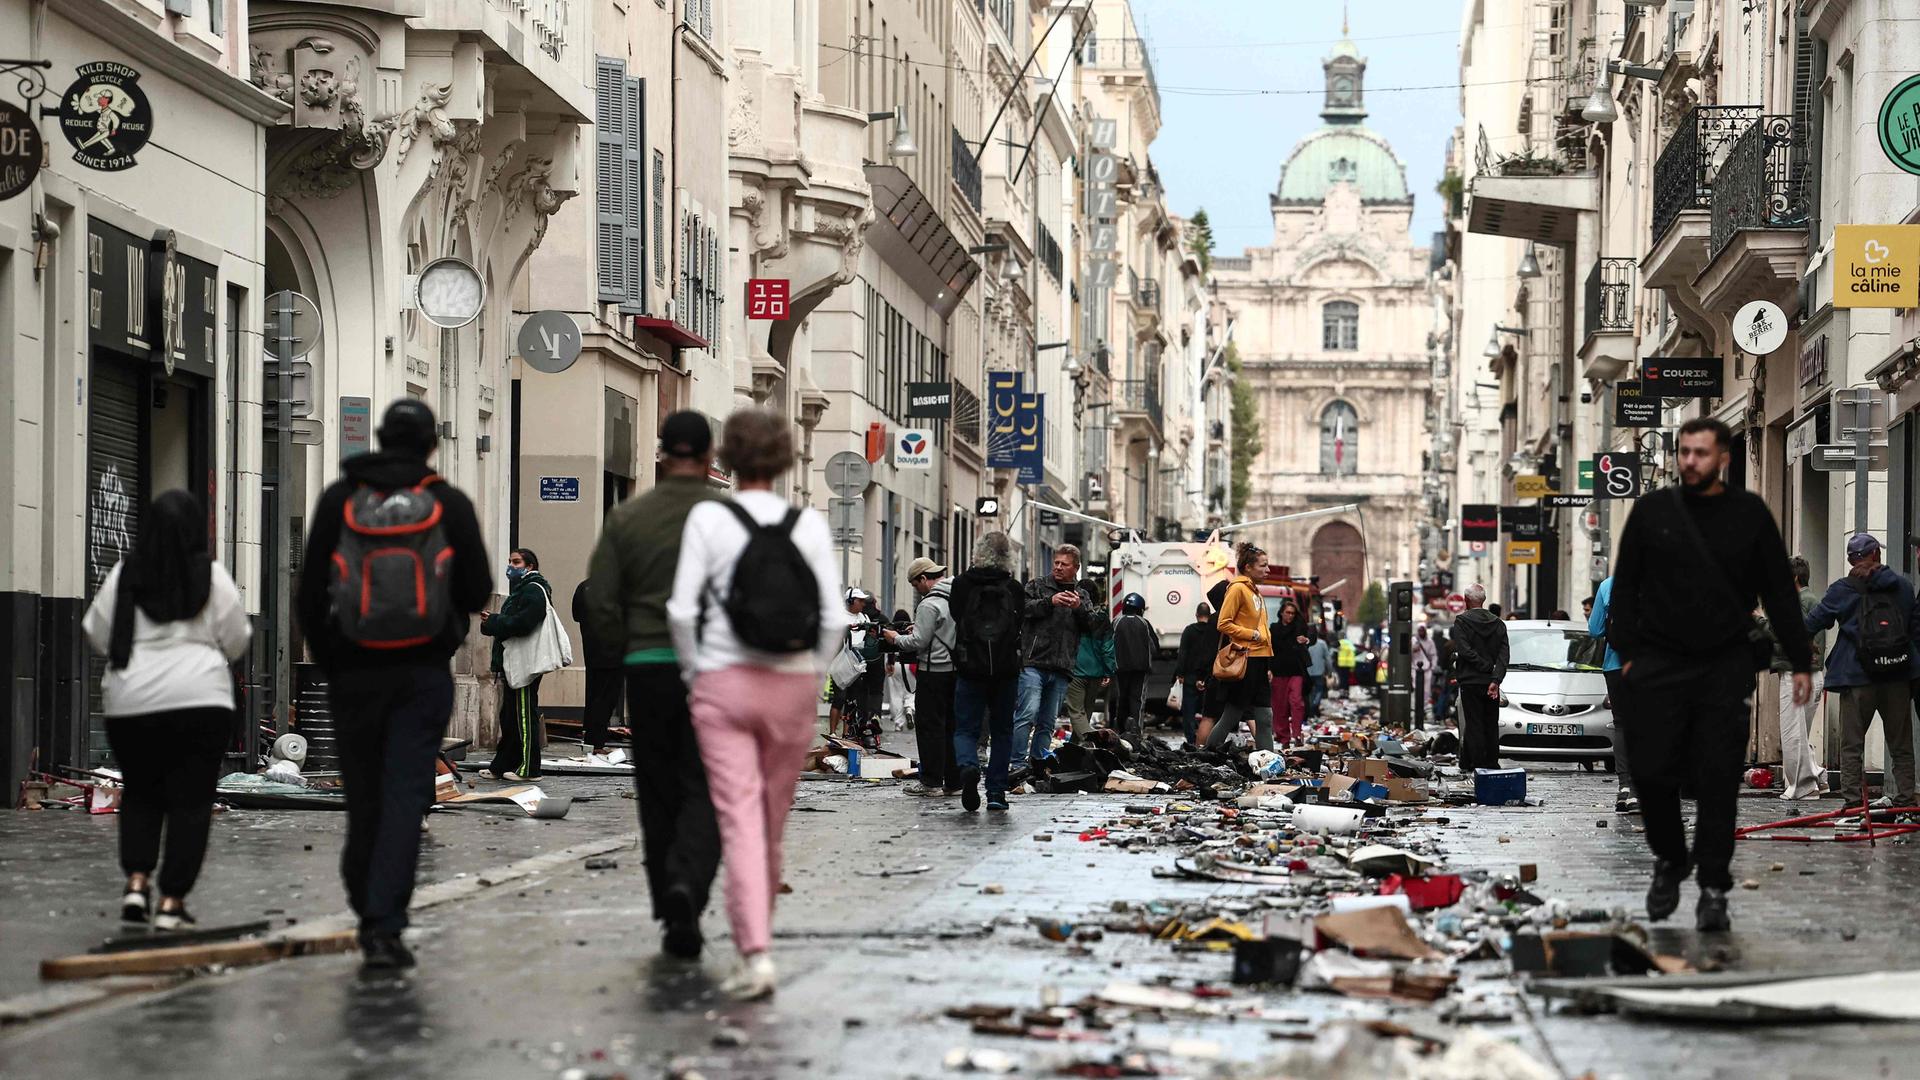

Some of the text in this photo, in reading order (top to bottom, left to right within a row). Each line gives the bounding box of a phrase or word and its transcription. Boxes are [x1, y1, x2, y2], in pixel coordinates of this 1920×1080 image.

[79, 63, 136, 78] KILO SHOP
[91, 75, 122, 85] RECYCLE
[65, 119, 93, 128] REDUCE
[121, 122, 145, 131] REUSE
[1897, 112, 1911, 131] LE
[75, 152, 132, 168] SINCE 1974
[1094, 121, 1114, 285] HOTEL
[1851, 262, 1901, 277] la mie
[1851, 278, 1900, 292] câline
[1748, 322, 1773, 339] BERRY
[1751, 319, 1767, 331] OAK
[1662, 369, 1709, 378] COURIR
[996, 370, 1016, 433] LCL
[1021, 392, 1039, 451] LCL
[896, 456, 929, 465] bouygues
[979, 500, 997, 513] JD
